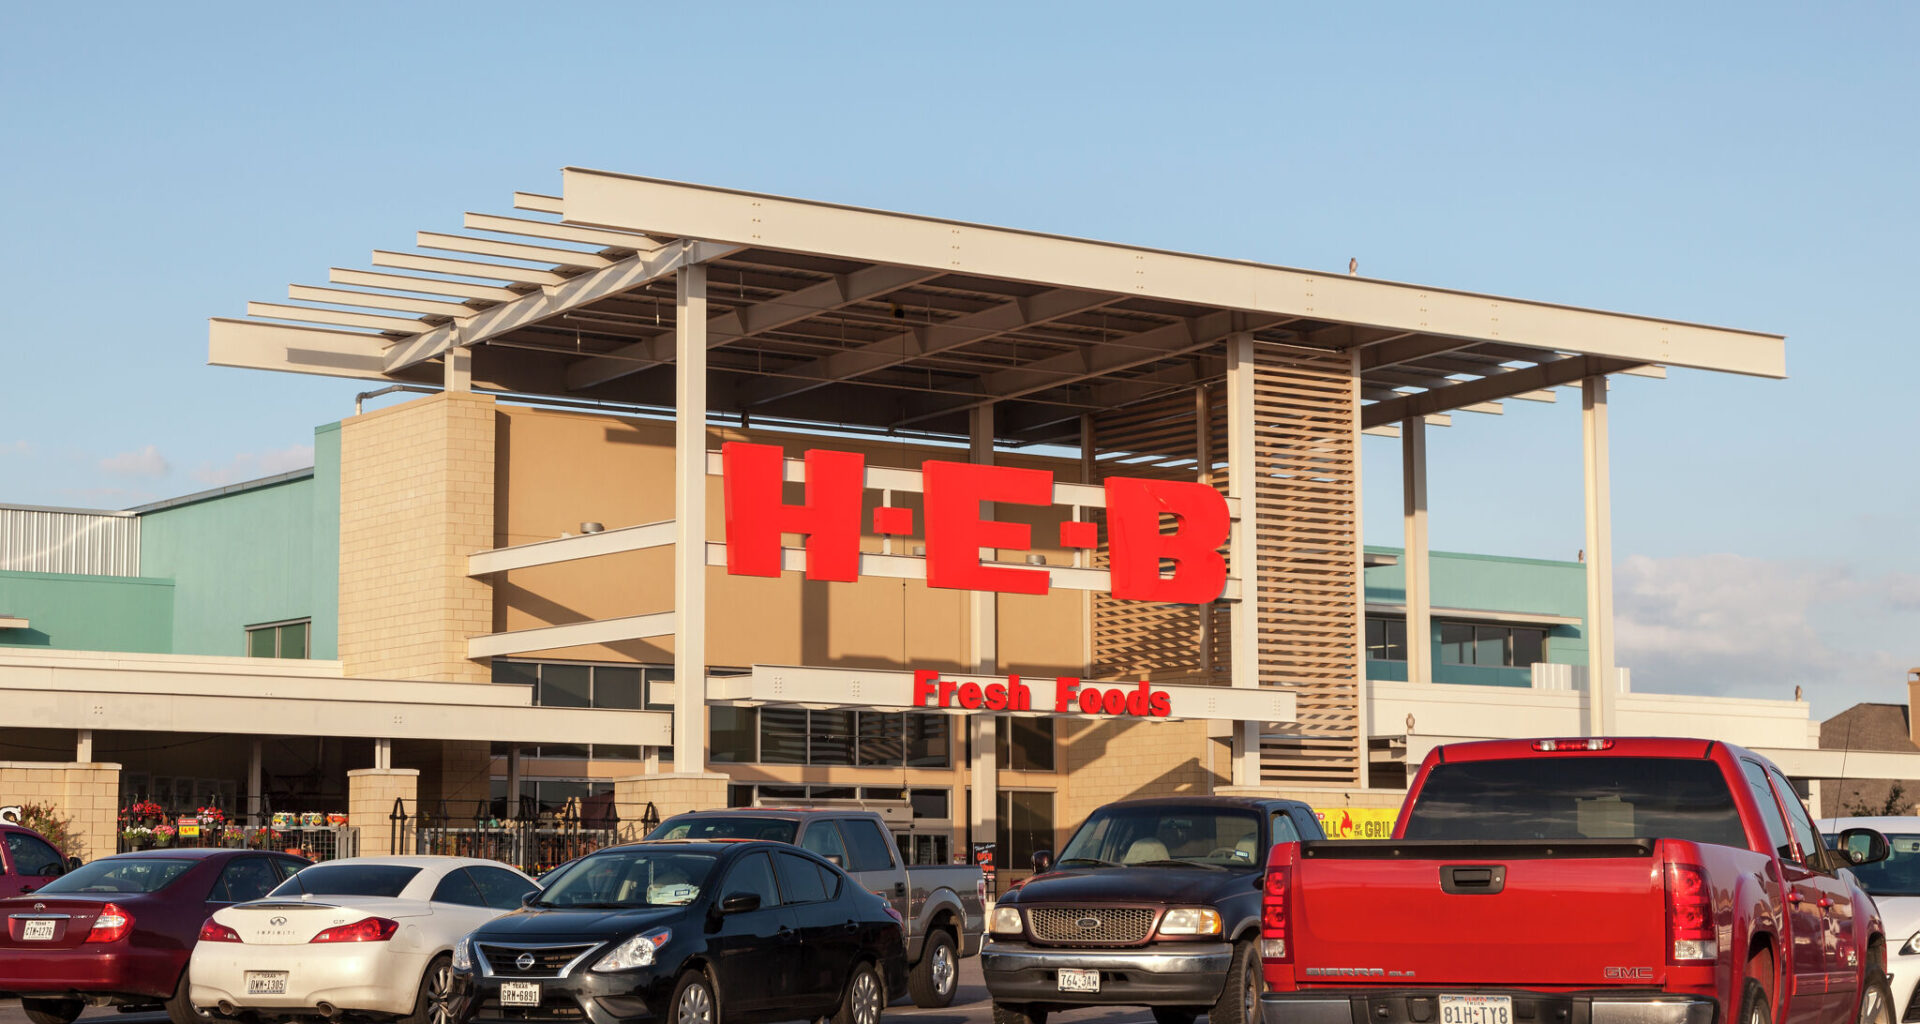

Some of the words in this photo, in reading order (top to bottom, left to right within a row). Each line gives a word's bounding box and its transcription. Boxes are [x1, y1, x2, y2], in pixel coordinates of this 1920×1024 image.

[913, 669, 1031, 711] Fresh
[1054, 676, 1172, 718] Foods
[977, 852, 992, 861] OPEN
[1305, 967, 1385, 977] SIERRA
[1603, 966, 1654, 979] GMC
